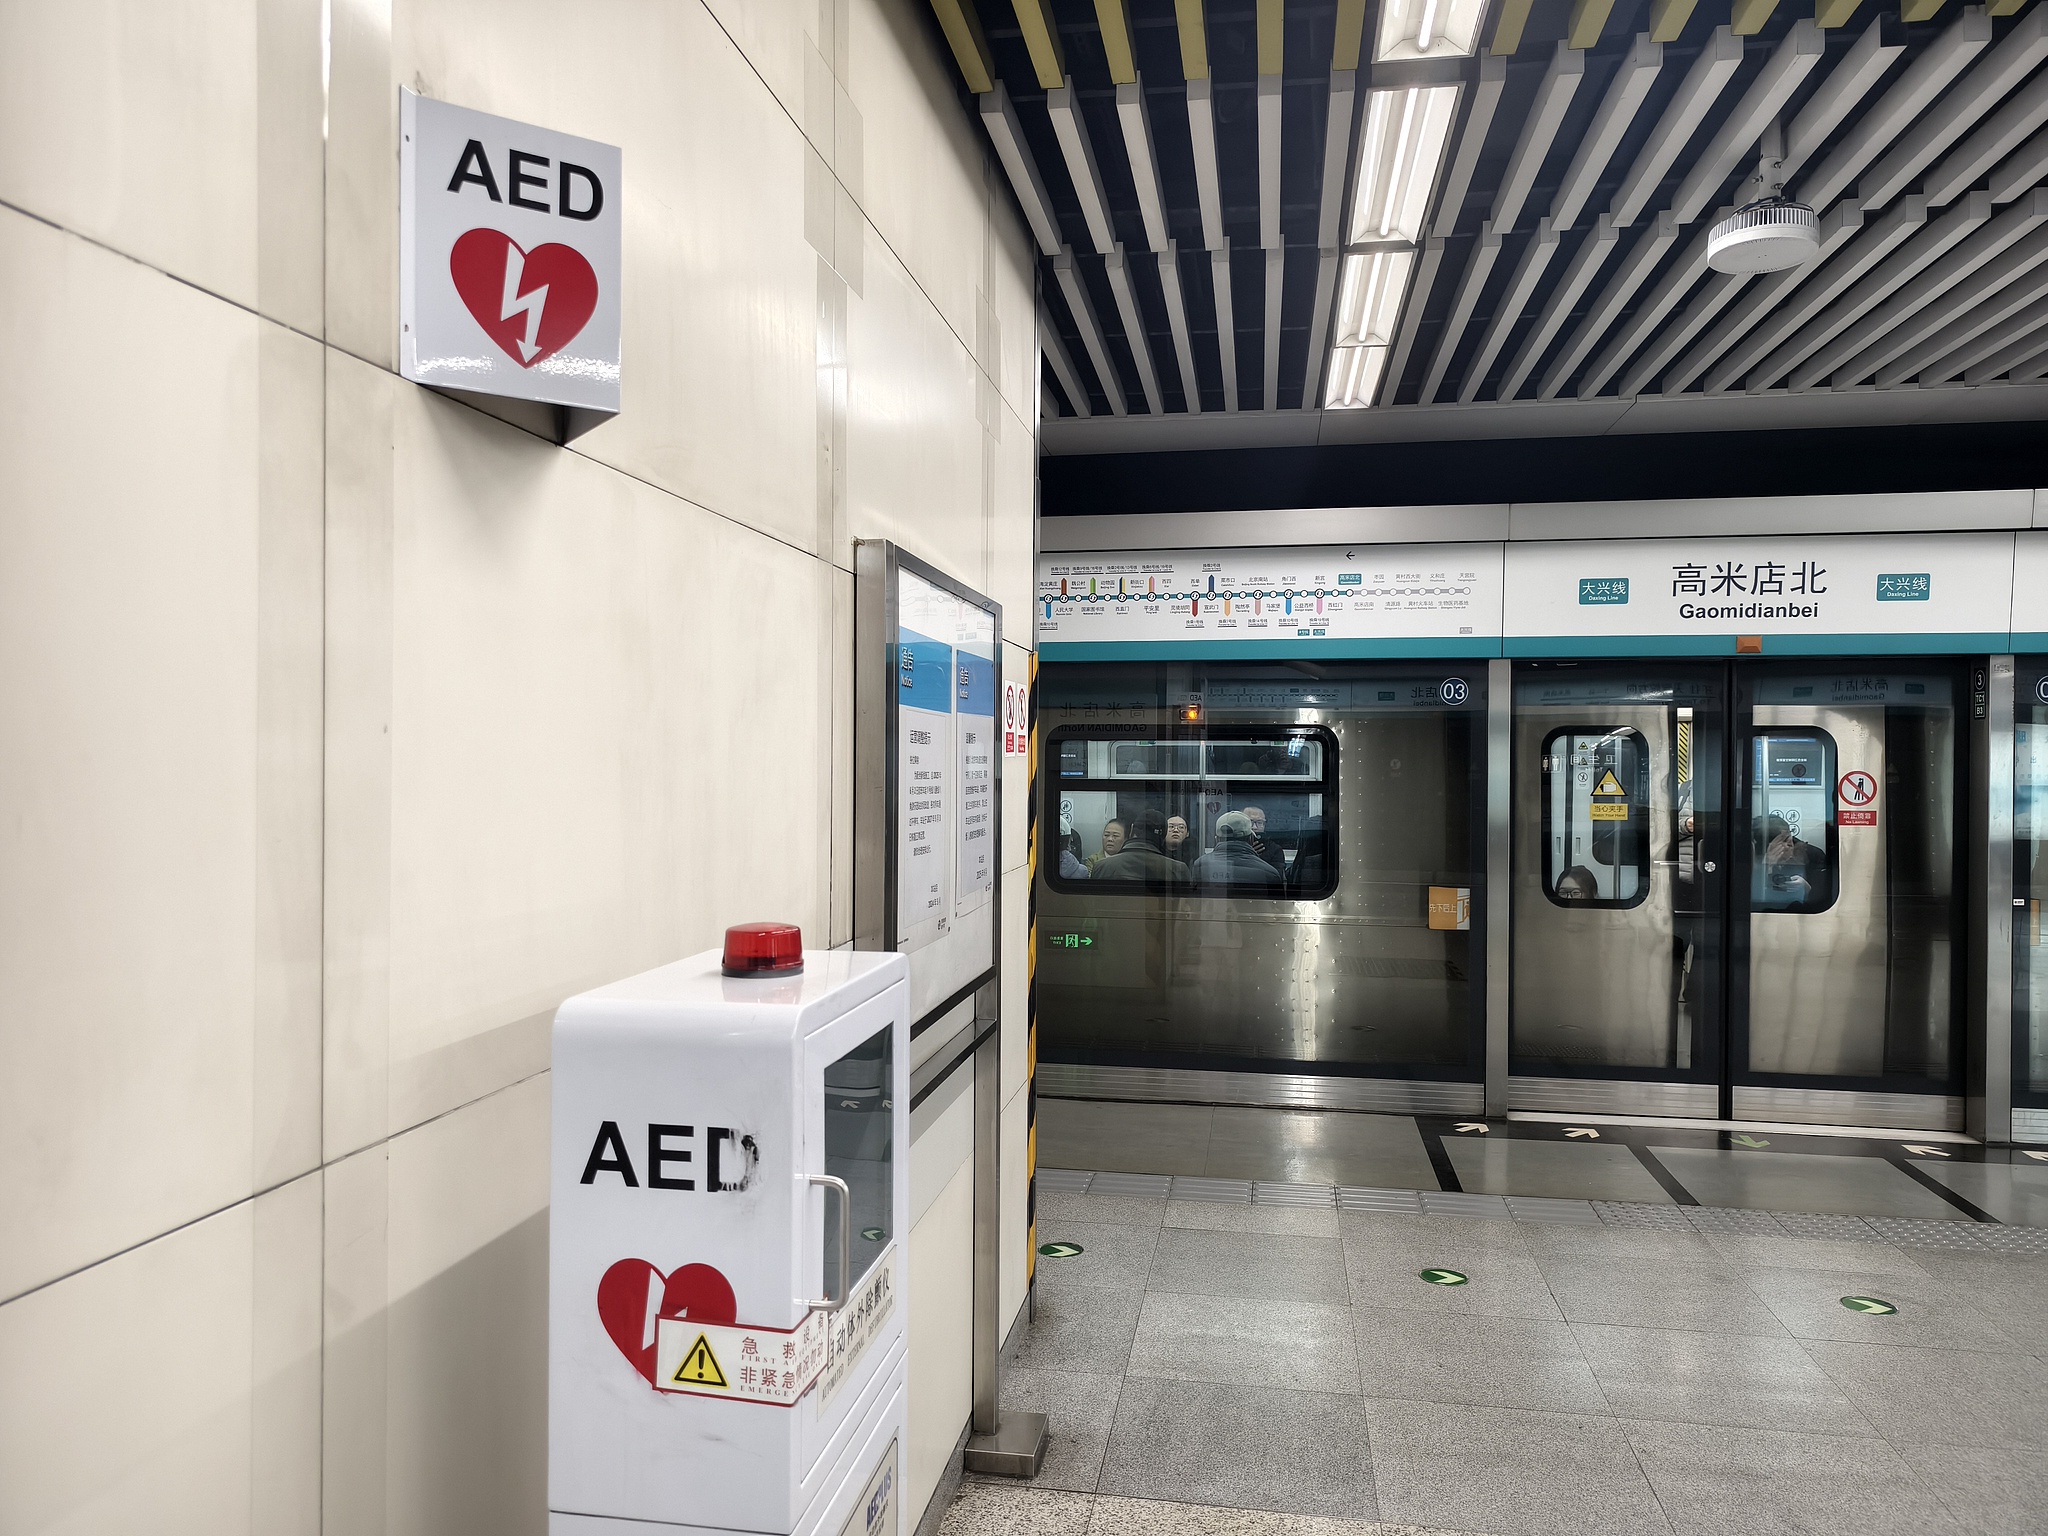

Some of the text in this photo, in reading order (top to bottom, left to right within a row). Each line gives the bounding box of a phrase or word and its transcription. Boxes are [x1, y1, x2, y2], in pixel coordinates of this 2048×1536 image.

[447, 139, 604, 221] AED
[1672, 561, 1828, 597] 高米店北
[1880, 577, 1928, 591] 大兴线
[1581, 581, 1626, 595] 大兴线
[1679, 602, 1818, 619] Gaomidianbei
[1977, 674, 1983, 686] 3
[1443, 683, 1465, 700] 03
[1594, 805, 1624, 813] 当心夹手
[1429, 903, 1457, 913] 先下后上
[827, 1267, 889, 1374] 自动体外除颤仪
[741, 1354, 776, 1364] FIRST
